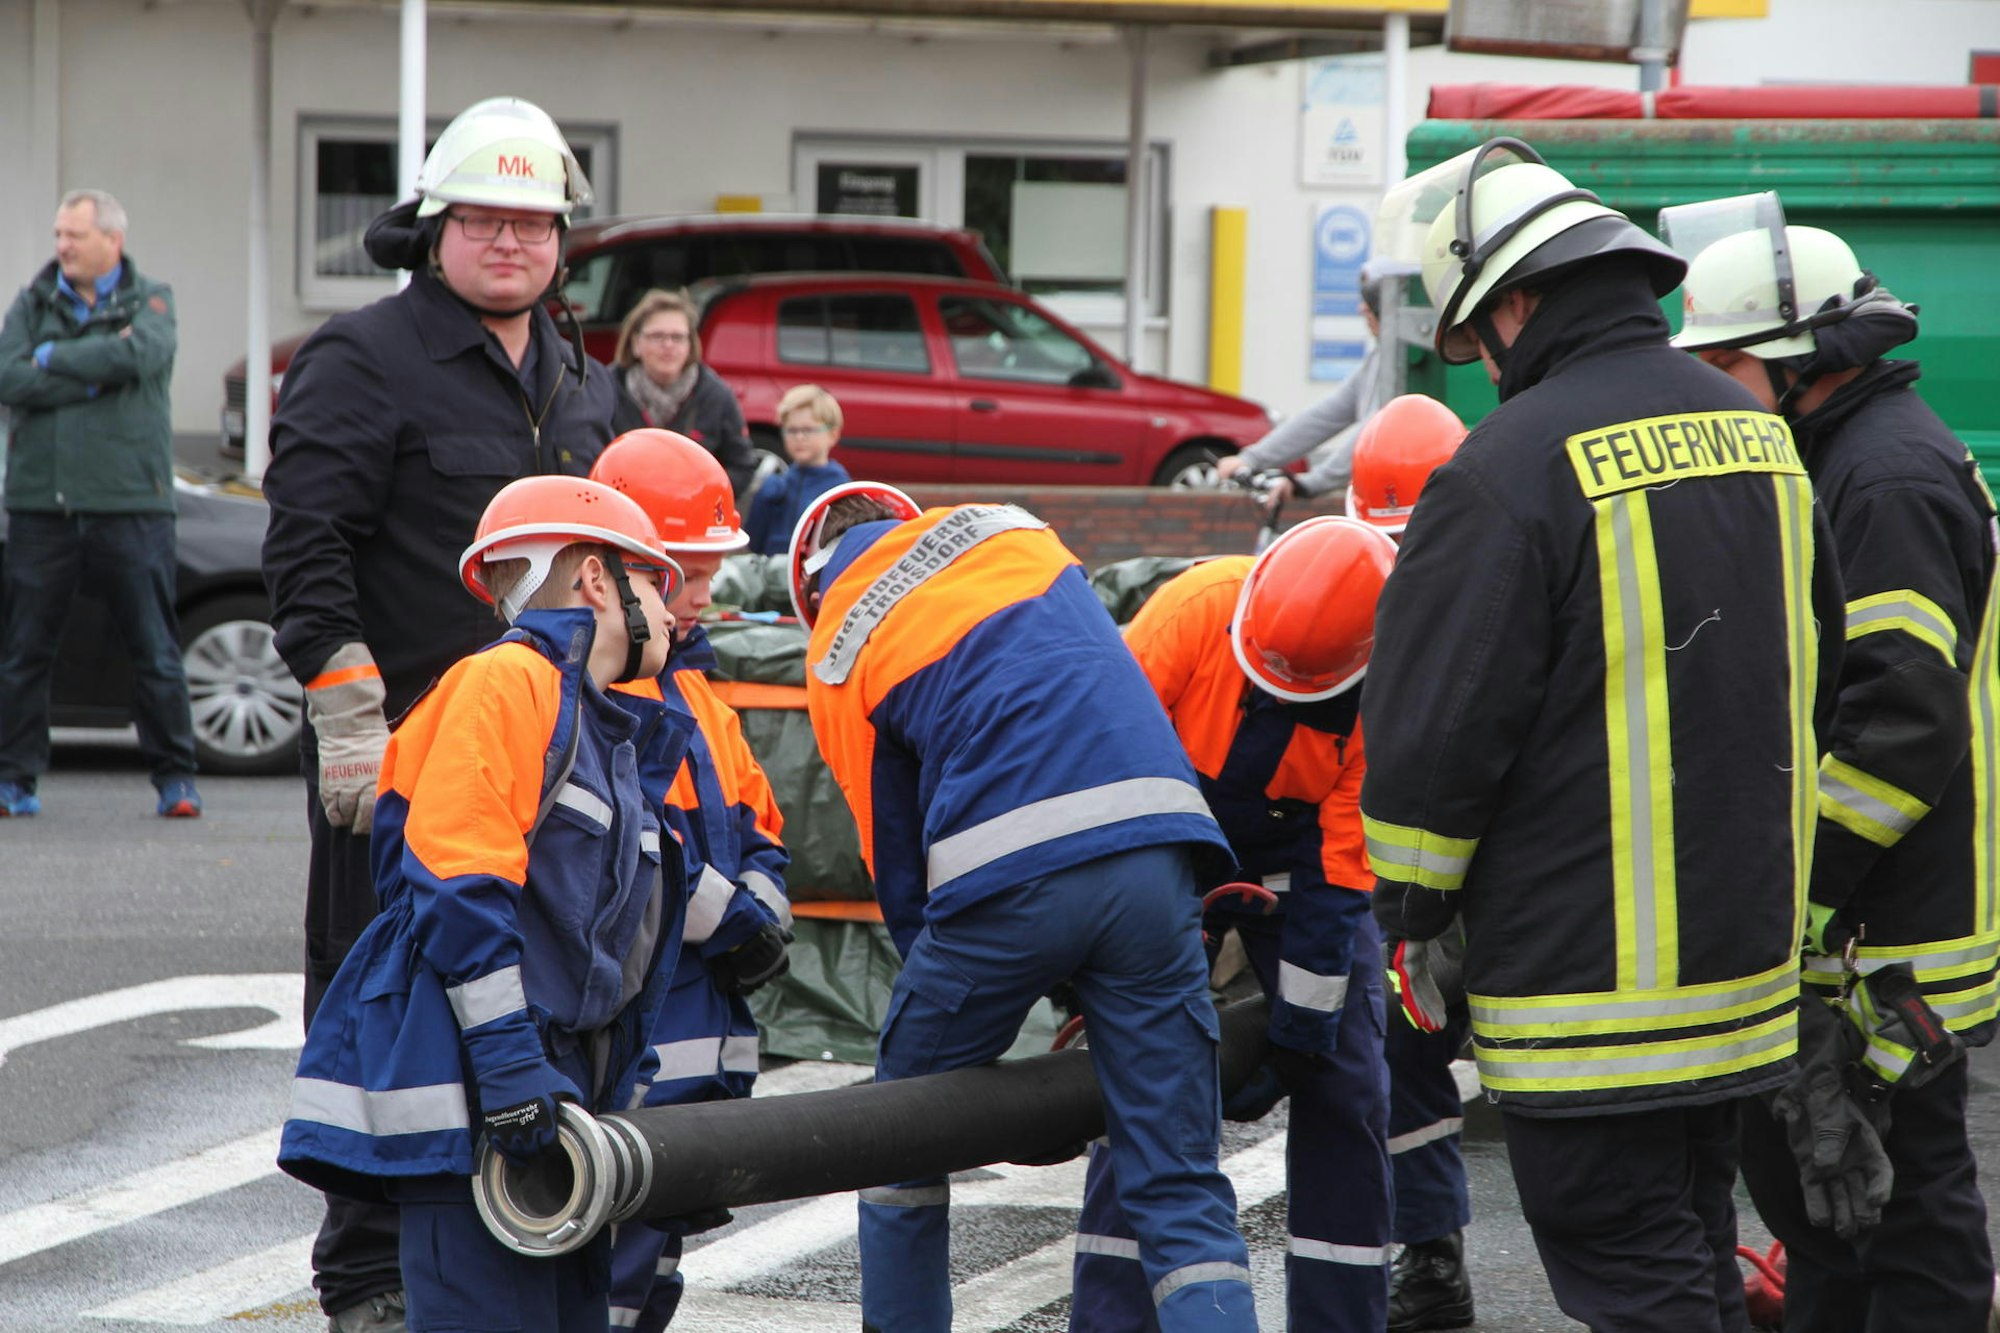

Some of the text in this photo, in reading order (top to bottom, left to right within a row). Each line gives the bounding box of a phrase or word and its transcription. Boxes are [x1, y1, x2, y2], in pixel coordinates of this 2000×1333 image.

[498, 154, 534, 178] Mk
[1580, 417, 1798, 487] FEUERWEHR
[827, 505, 1009, 666] JUGENDFEUERWE
[864, 524, 980, 620] TROISDORF
